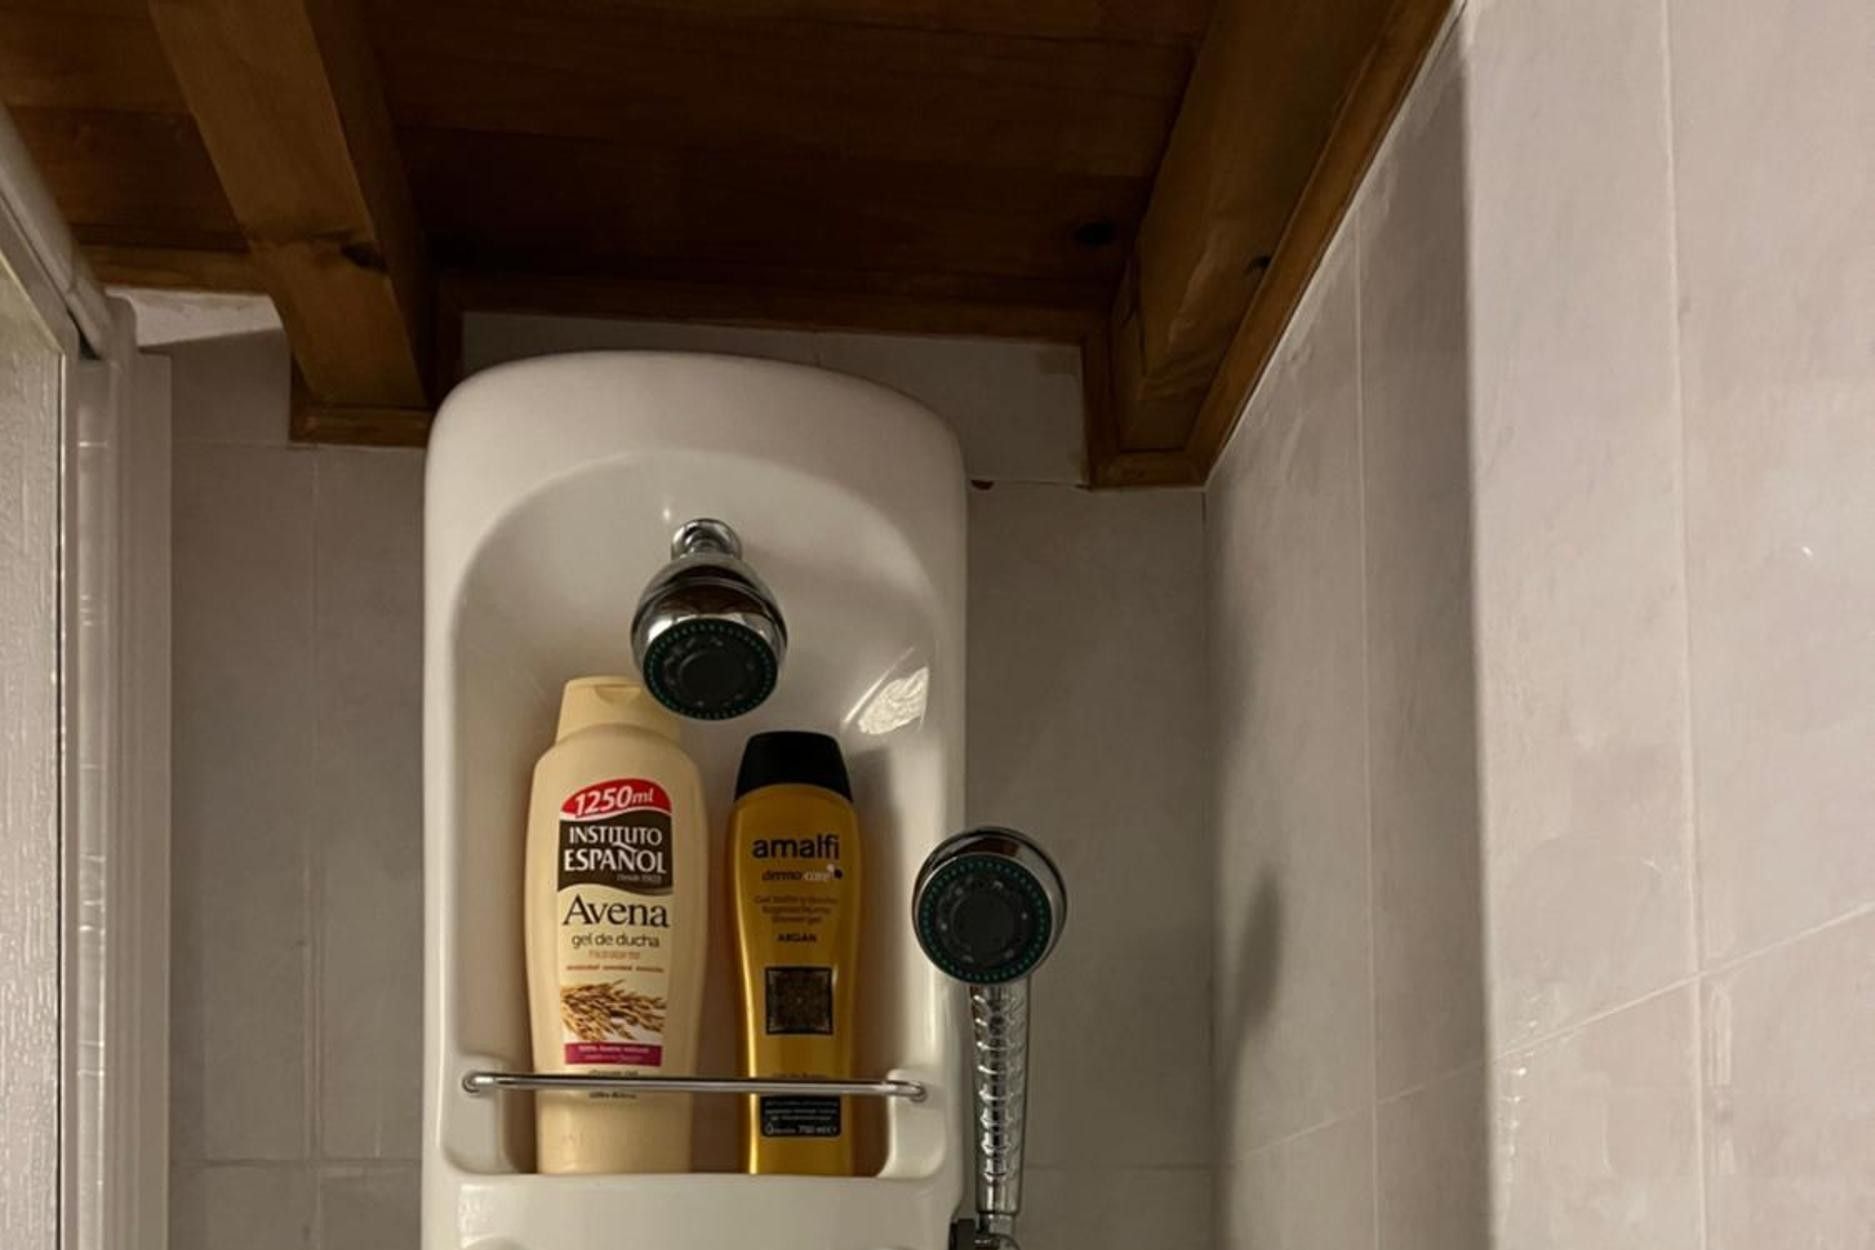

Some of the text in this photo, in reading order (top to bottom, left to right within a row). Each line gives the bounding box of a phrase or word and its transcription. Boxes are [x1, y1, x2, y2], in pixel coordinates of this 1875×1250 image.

[569, 825, 663, 847] INSTITUTO
[753, 833, 839, 860] amalfi
[564, 847, 667, 874] ESPAÑOL
[562, 894, 670, 928] Avena
[571, 932, 660, 949] gel de ducha
